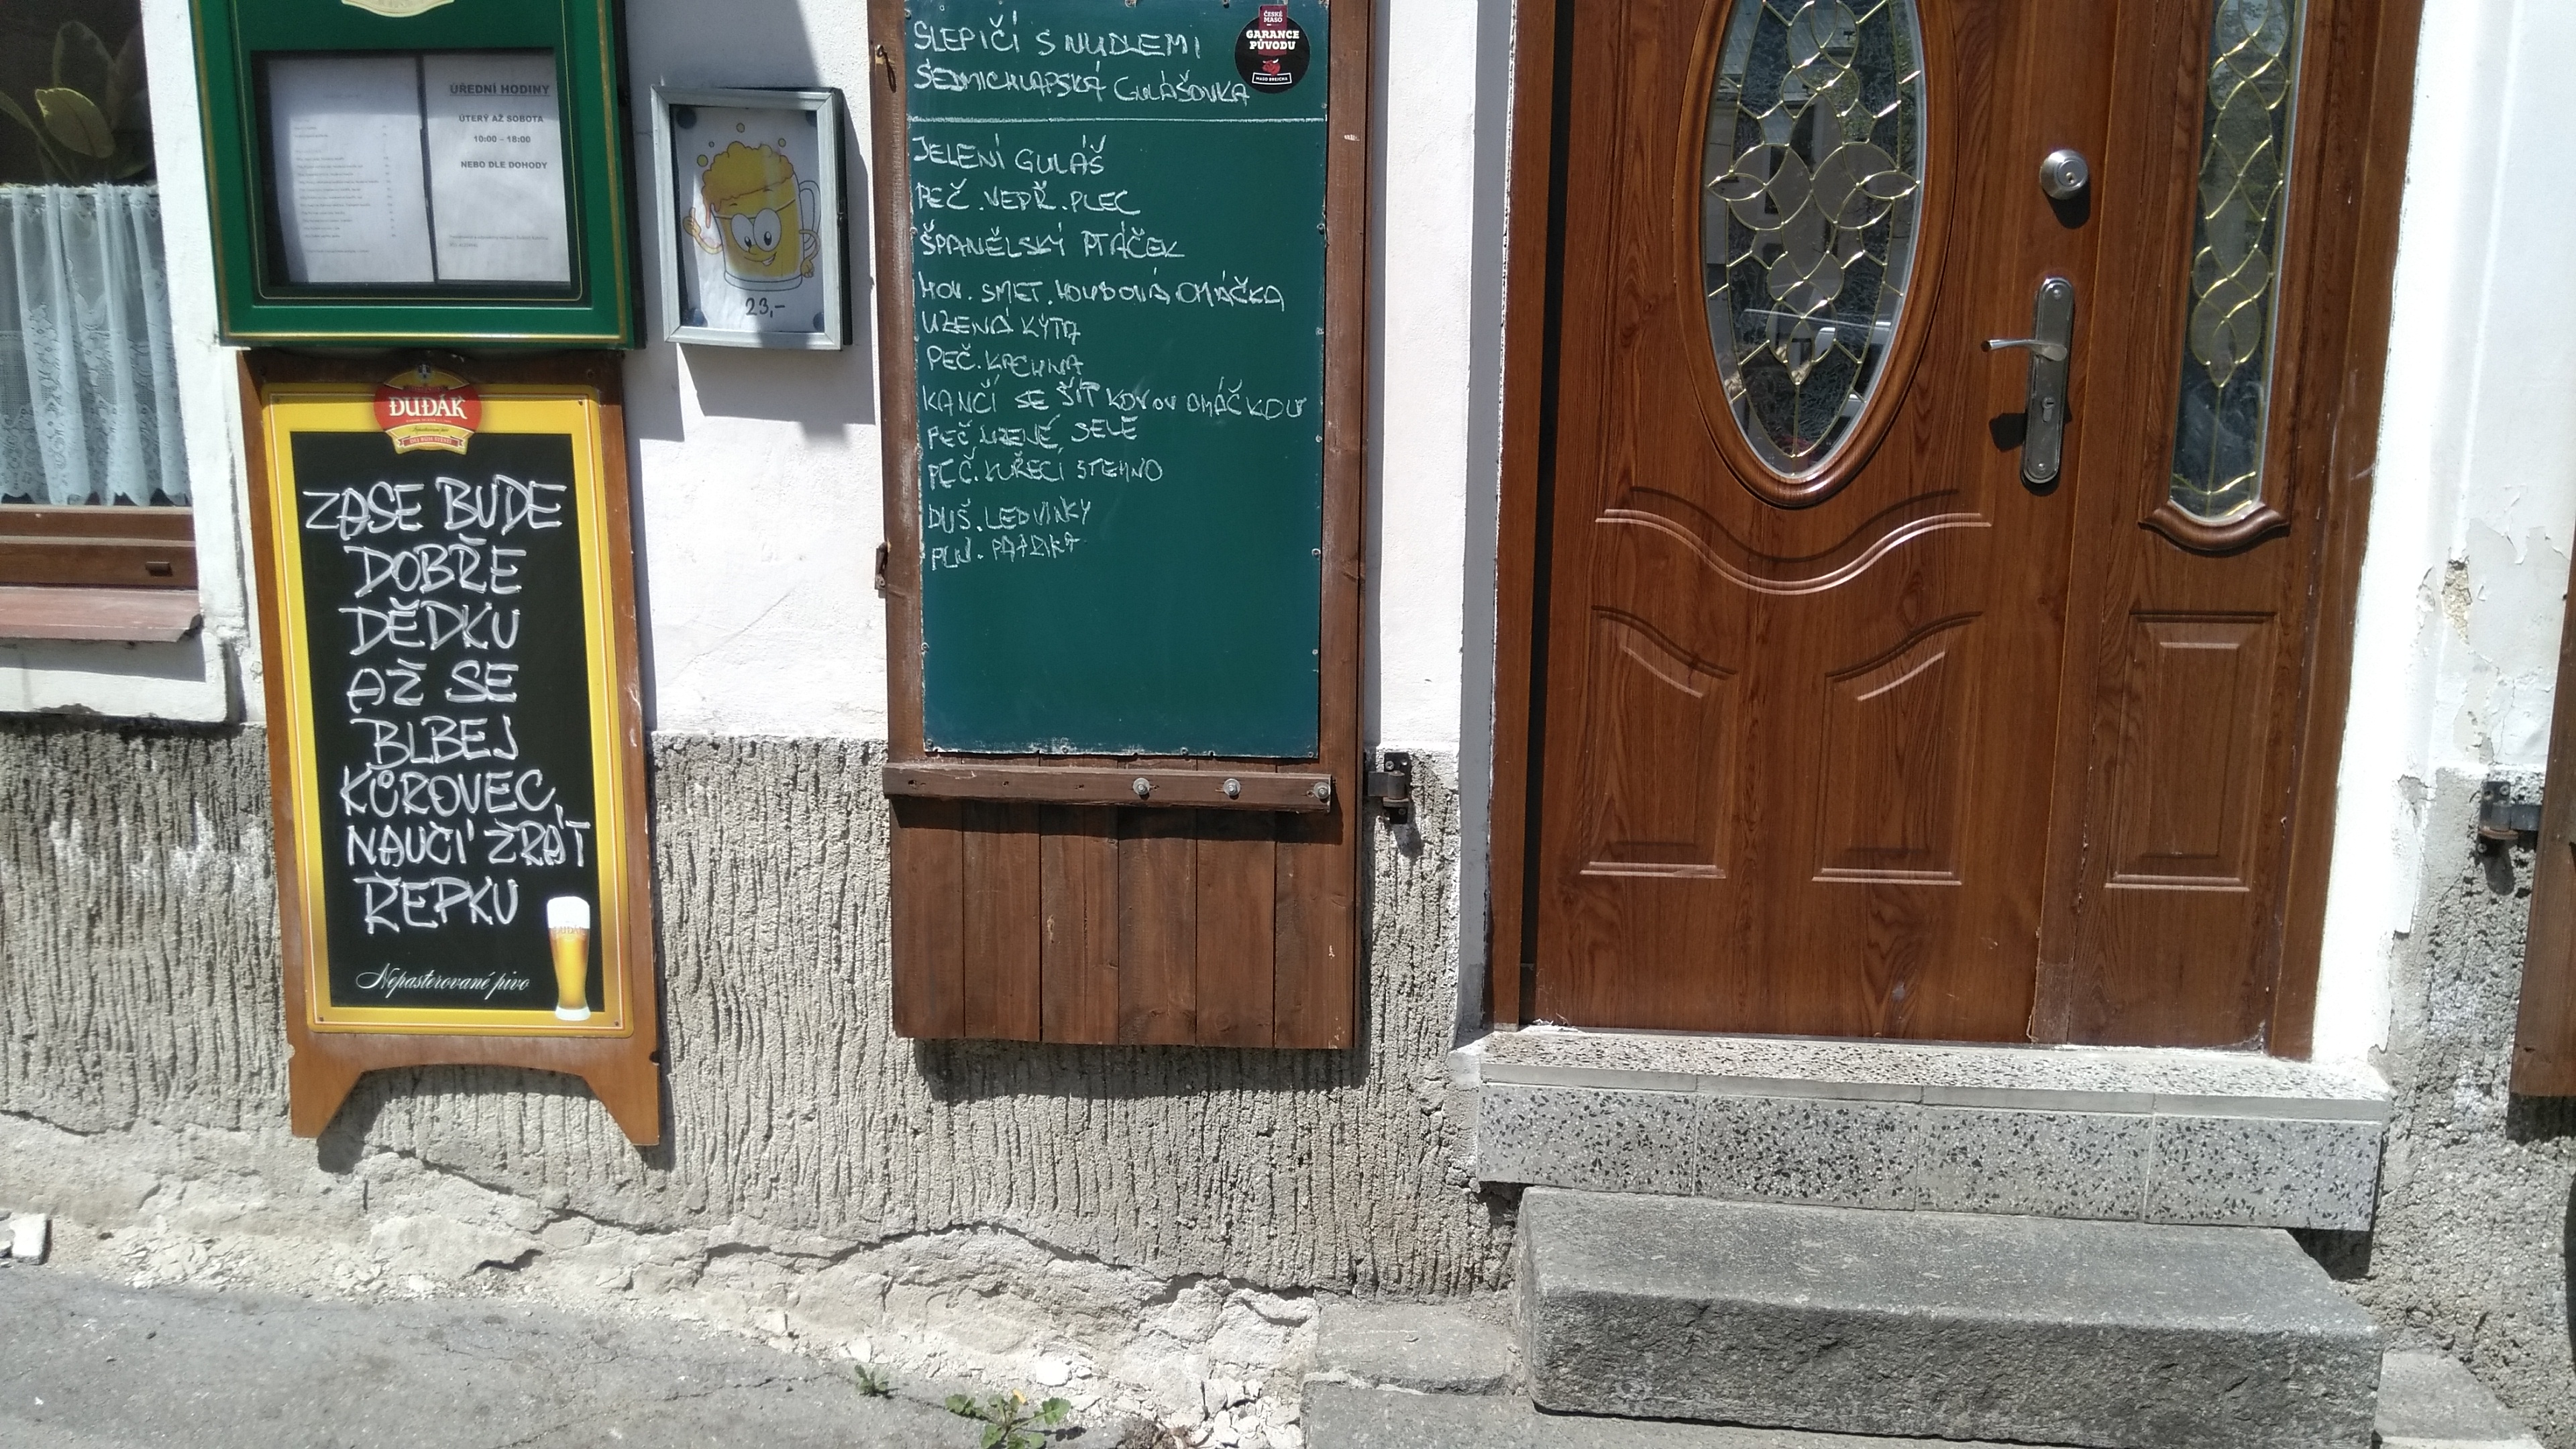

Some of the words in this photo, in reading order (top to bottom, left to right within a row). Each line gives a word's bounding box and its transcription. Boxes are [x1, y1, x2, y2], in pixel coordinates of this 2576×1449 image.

[1036, 29, 1056, 56] S
[1246, 30, 1299, 39] GARANCE
[1249, 38, 1295, 50] PŮVODU
[450, 83, 496, 94] ÚŘEDNÍ
[501, 85, 549, 94] HODINY
[459, 114, 489, 122] ÚTERÝ
[492, 114, 504, 122] AŽ
[912, 133, 1005, 170] JELENÍ
[1014, 135, 1106, 174] GULÁŠ
[1070, 190, 1140, 216] PLEC
[920, 219, 1065, 258] ŠPANĚLSKÝ
[1081, 221, 1185, 260] PTÁČEK
[745, 297, 785, 318] 23,-
[1175, 270, 1285, 312] OMÁČKA
[922, 374, 1000, 416] KANČÍ
[1014, 390, 1049, 410] SE
[1077, 458, 1163, 483] STEHNO
[303, 481, 425, 541] ZASE
[435, 474, 567, 536] BUDE
[343, 533, 527, 598] DOBŘE
[339, 597, 521, 655] DĚDKU
[347, 658, 427, 713] AŽ
[445, 660, 519, 702] SE
[350, 714, 519, 770] BLBEJ
[340, 765, 555, 818] KŮROVEC
[484, 804, 590, 867] ŽRÁT
[354, 871, 519, 934] ŘEPKU
[356, 963, 496, 998] Nepasterované
[484, 971, 530, 1000] pivo
